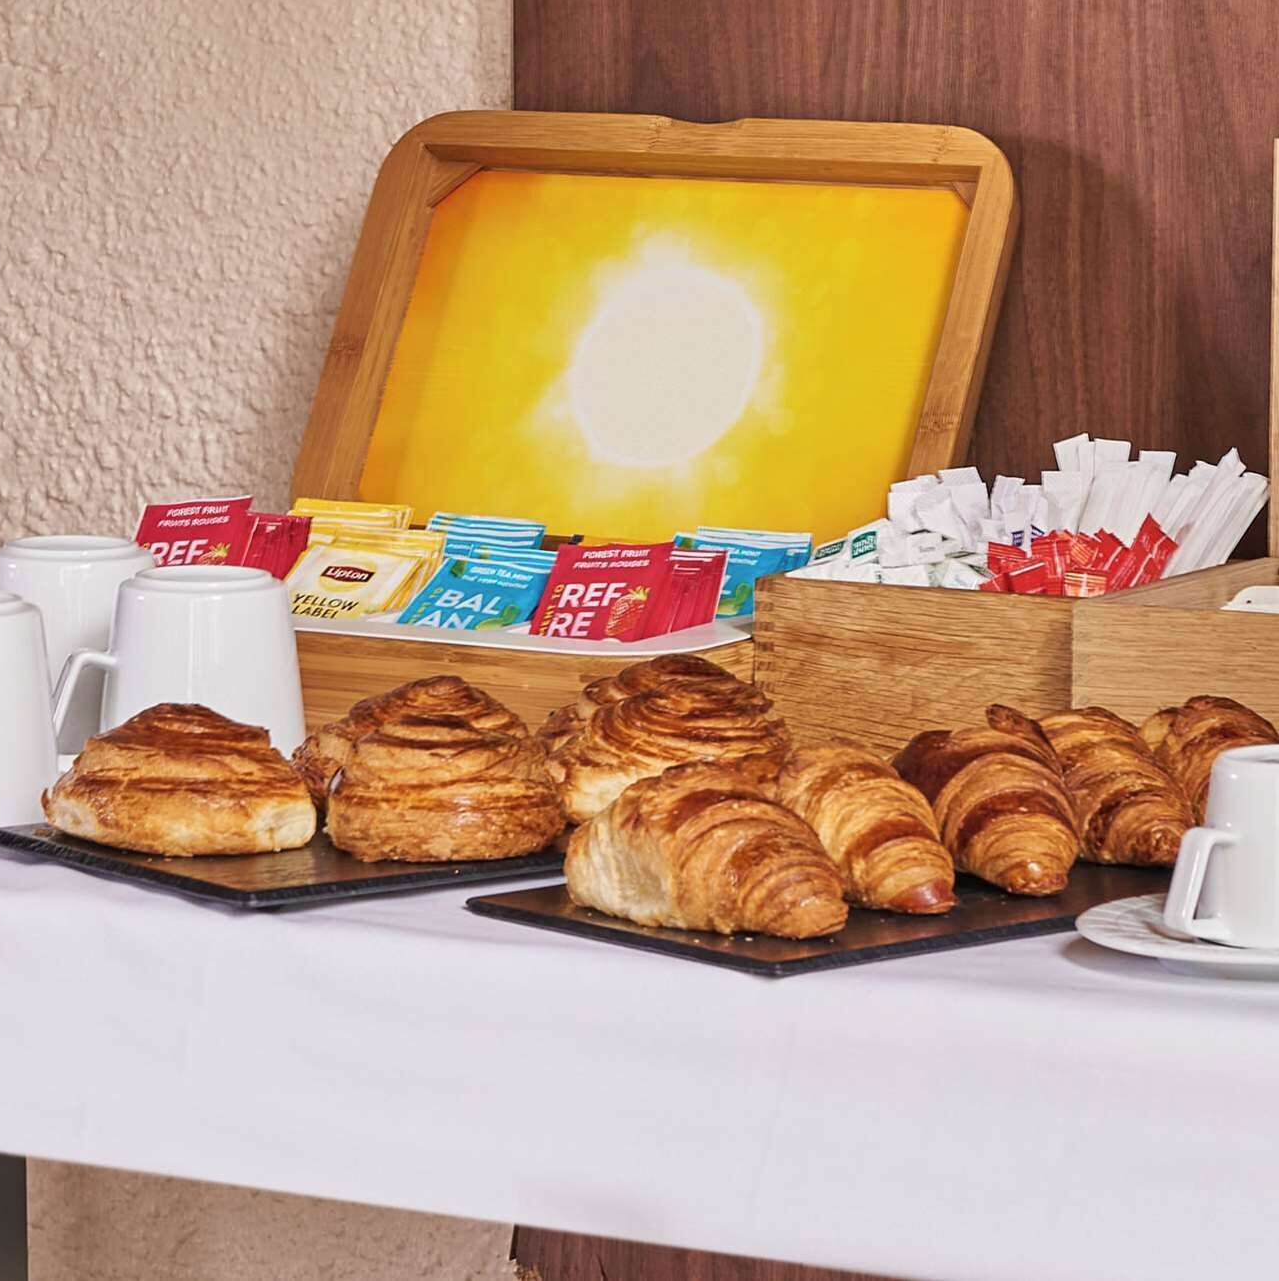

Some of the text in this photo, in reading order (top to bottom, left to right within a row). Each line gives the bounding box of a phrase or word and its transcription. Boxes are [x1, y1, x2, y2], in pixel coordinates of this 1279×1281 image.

[150, 539, 209, 566] REF
[325, 567, 370, 581] Lipton
[293, 593, 360, 611] YELLOW
[435, 589, 502, 616] BAL
[557, 582, 628, 608] REF
[414, 610, 475, 630] AN
[546, 611, 596, 637] RE
